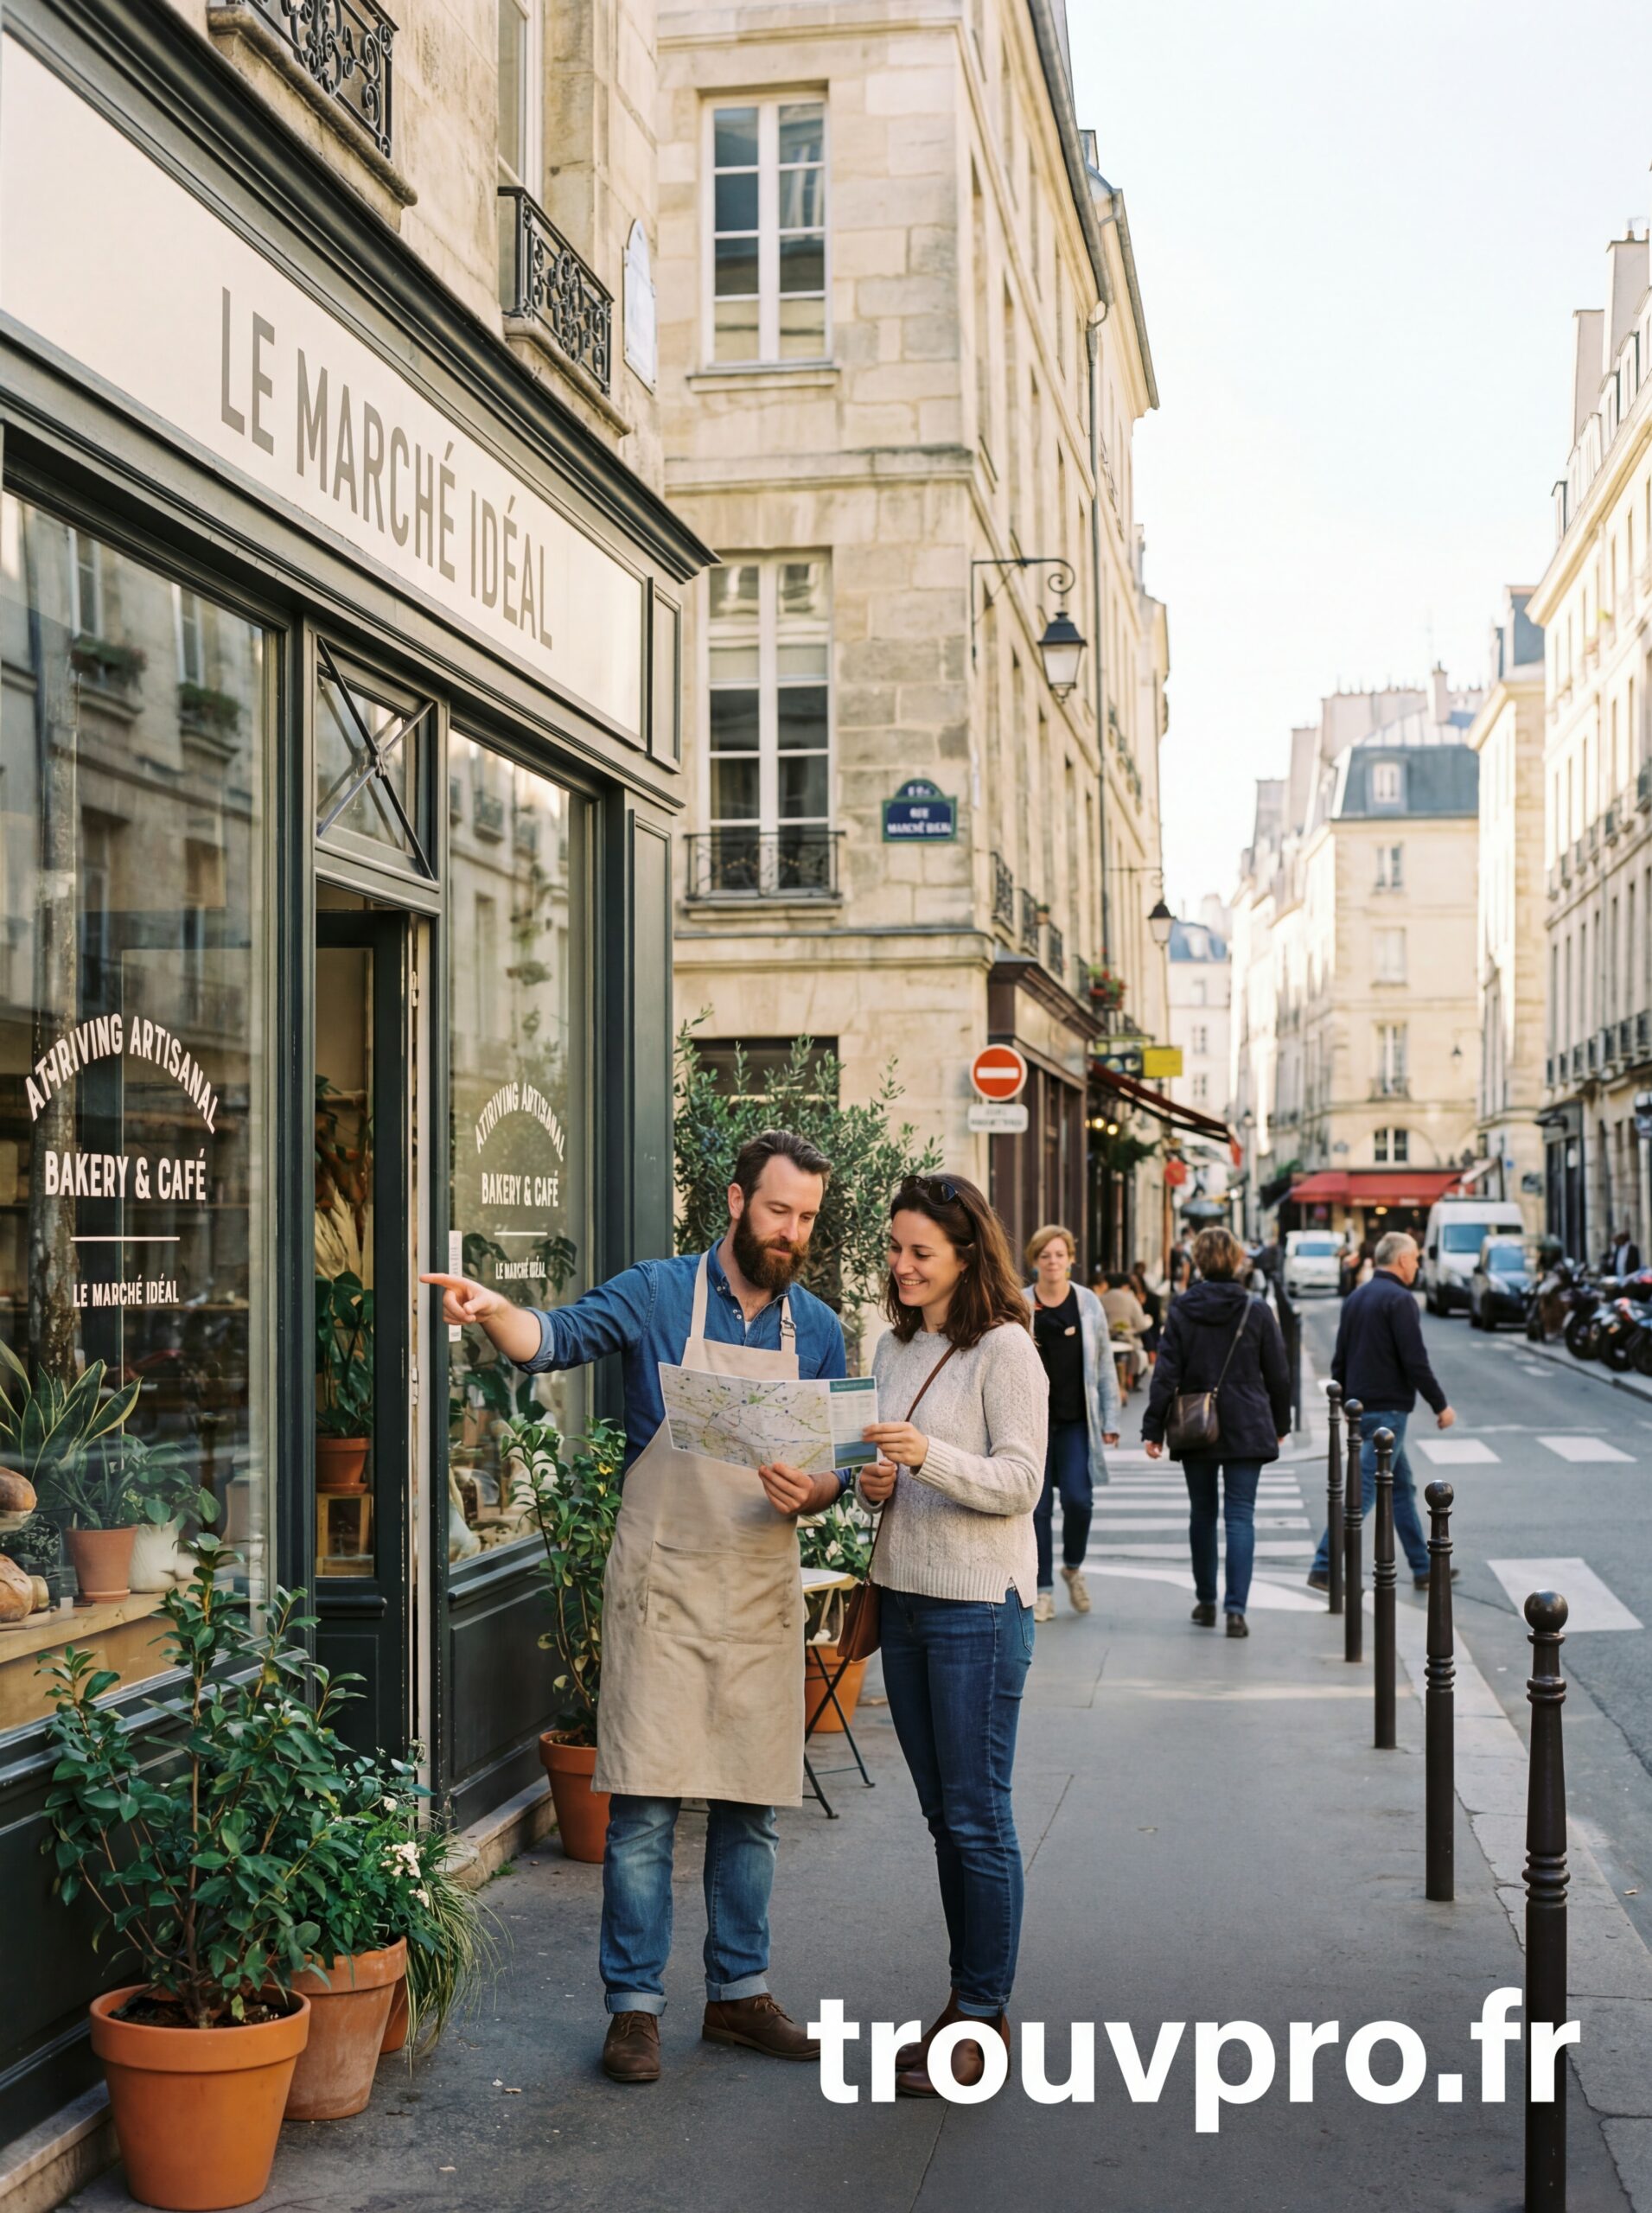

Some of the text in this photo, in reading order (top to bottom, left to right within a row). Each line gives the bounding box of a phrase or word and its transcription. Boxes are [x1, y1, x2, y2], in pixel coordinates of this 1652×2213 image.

[221, 286, 552, 651] LE MARCHÉ IDÉAL
[129, 1016, 218, 1134] ARTISANAL
[45, 1148, 207, 1201] BAKERY & CAFÉ
[482, 1170, 558, 1207] BAKERY & CAFÉ
[73, 1272, 180, 1307] LE MARCHÉ IDÉAL
[495, 1262, 503, 1280] LE
